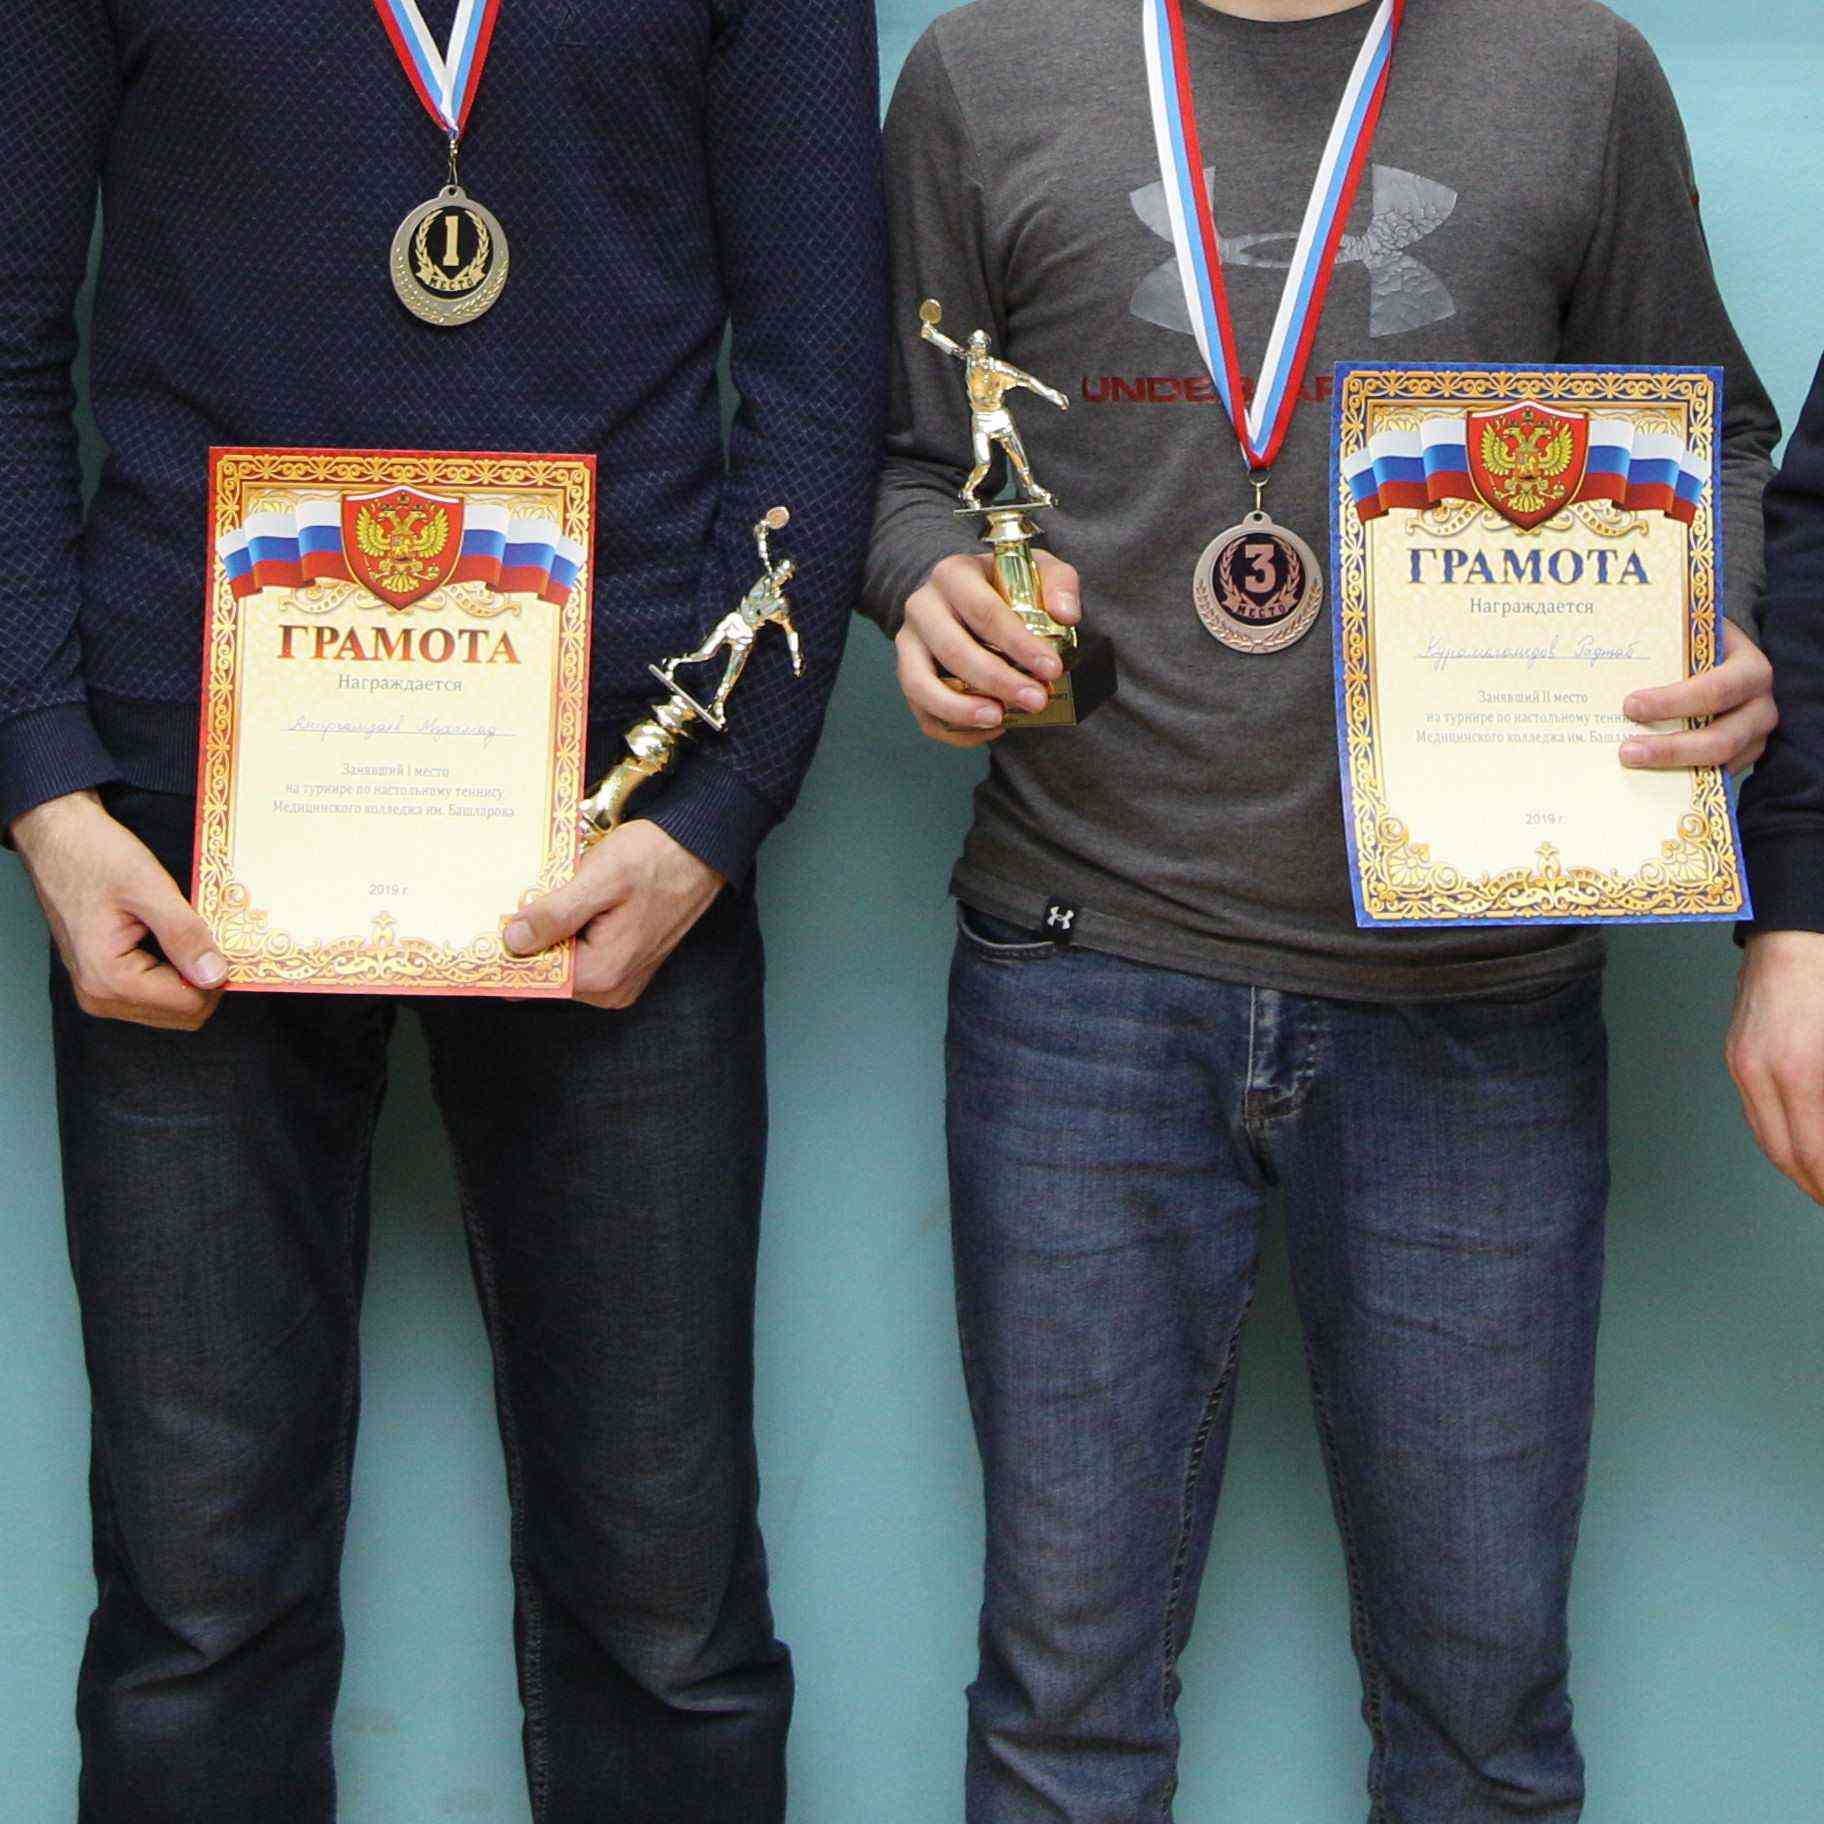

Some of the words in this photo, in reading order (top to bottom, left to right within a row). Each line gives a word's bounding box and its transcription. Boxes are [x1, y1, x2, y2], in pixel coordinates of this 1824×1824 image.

[1244, 543, 1277, 594] 3
[1406, 547, 1651, 587] ГРАМОТА
[1469, 597, 1595, 618] Награждается
[276, 623, 522, 665] ГРАМОТА
[337, 673, 464, 694] Награждается
[1478, 689, 1540, 704] Занявший
[1553, 693, 1589, 704] место
[1425, 712, 1441, 723] на
[1443, 712, 1495, 727] турнире
[1497, 713, 1512, 723] по
[1513, 713, 1591, 727] настольному
[1415, 728, 1505, 745] Медицинского
[1507, 730, 1566, 745] колледжа
[341, 762, 405, 777] Занявший
[413, 766, 451, 778] место
[285, 783, 300, 794] на
[303, 783, 354, 798] турнире
[356, 785, 372, 795] по
[373, 785, 452, 799] настольному
[455, 786, 505, 801] теннису
[272, 799, 363, 816] Медицинского
[447, 803, 516, 821] Башларова
[368, 883, 400, 897] 2019
